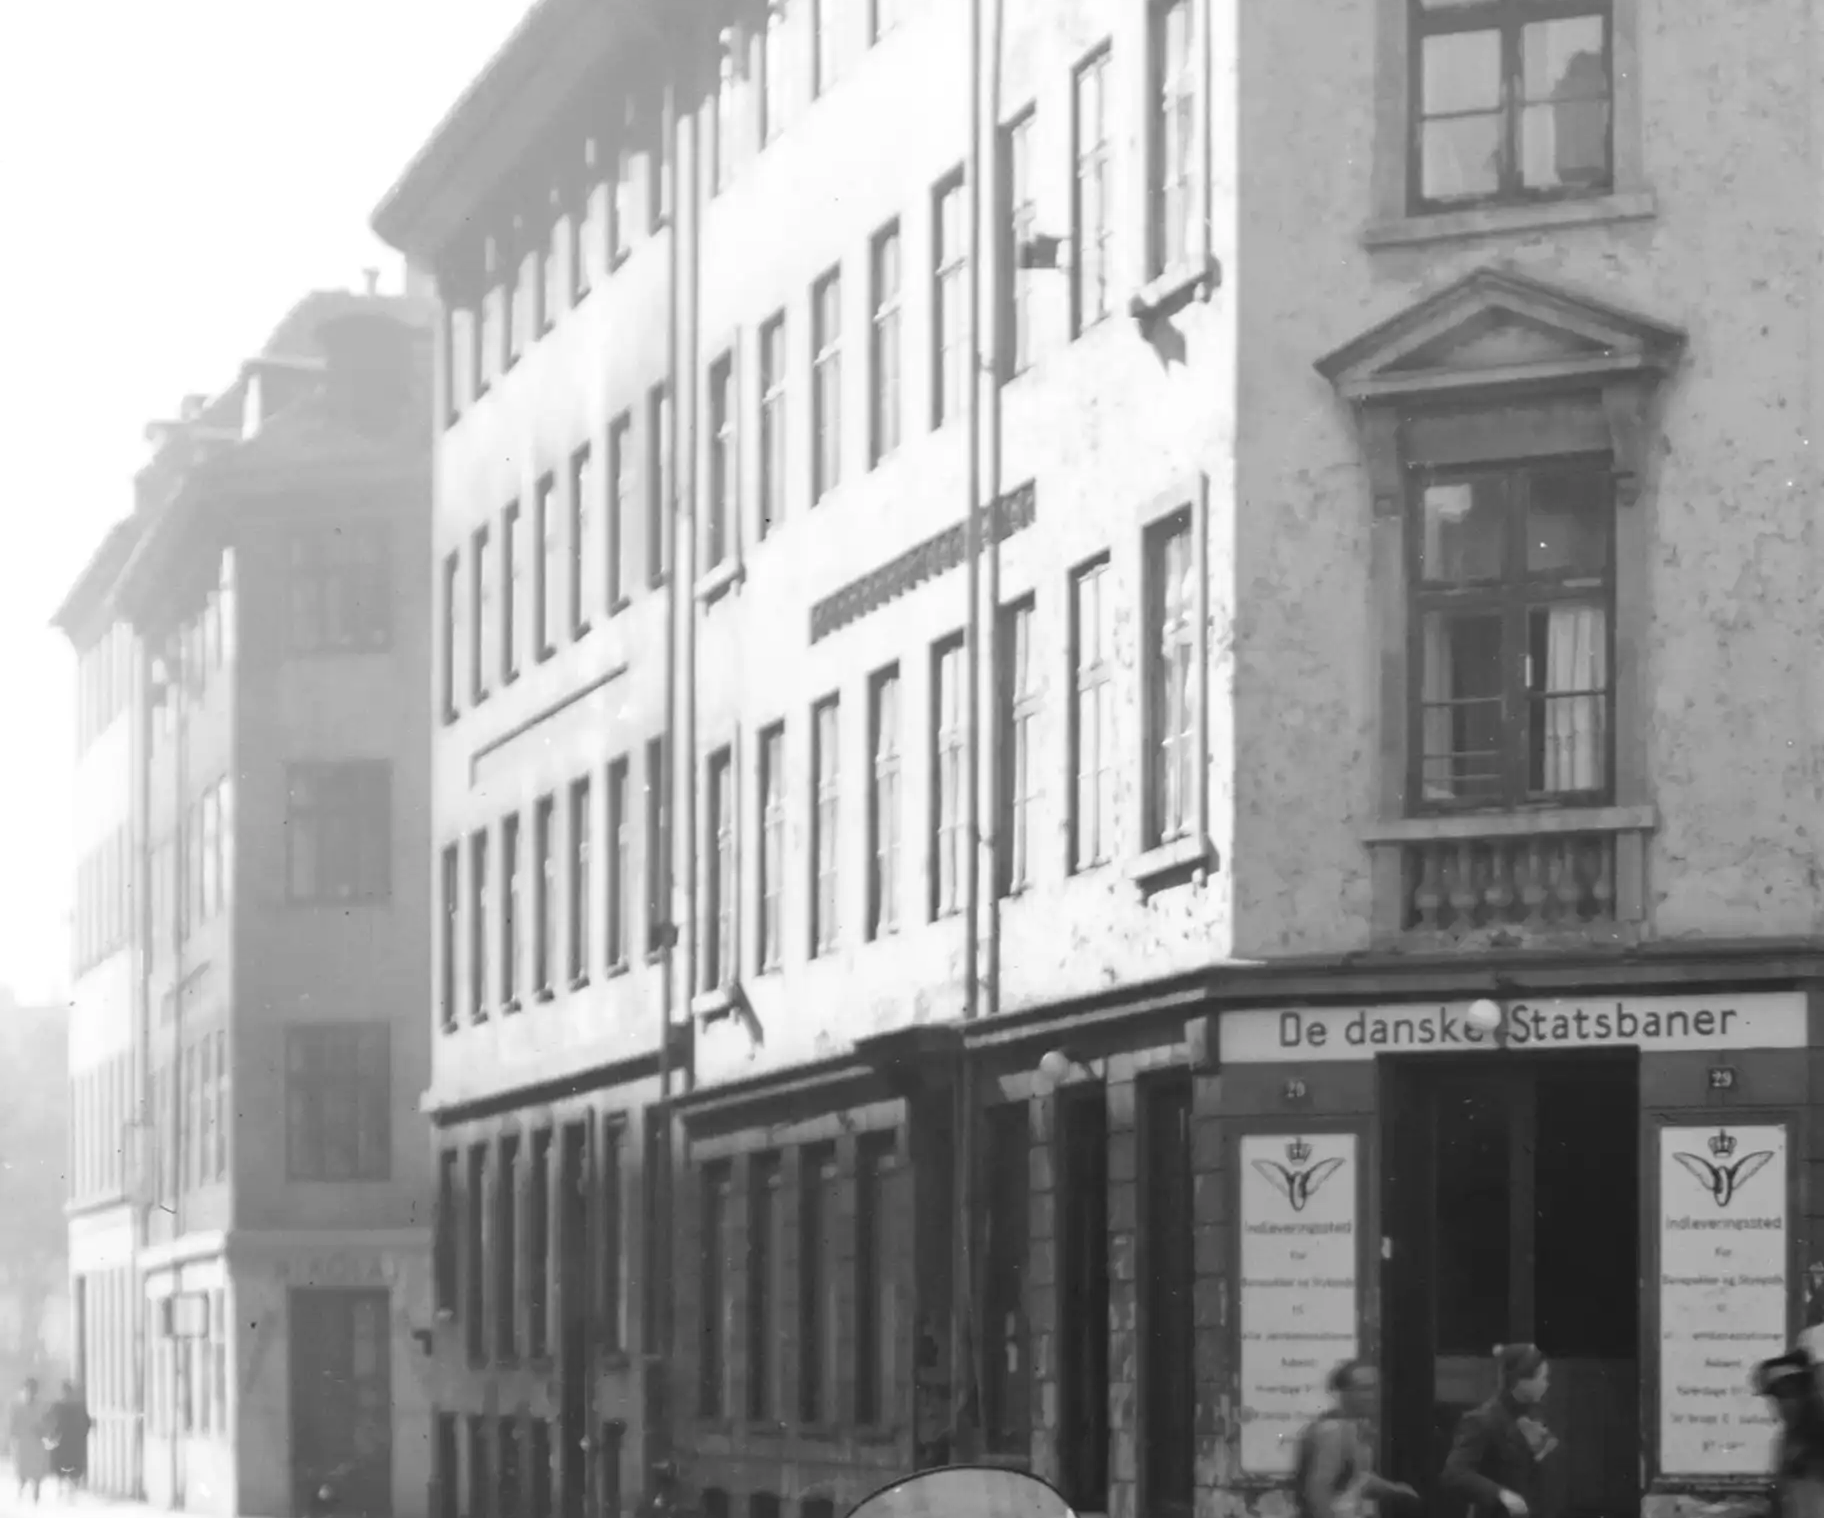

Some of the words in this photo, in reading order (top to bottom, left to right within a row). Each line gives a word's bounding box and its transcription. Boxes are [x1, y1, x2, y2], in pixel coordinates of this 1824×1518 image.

[1279, 1010, 1328, 1048] De
[1344, 1005, 1484, 1046] danske
[1511, 1000, 1738, 1043] Statsbaner
